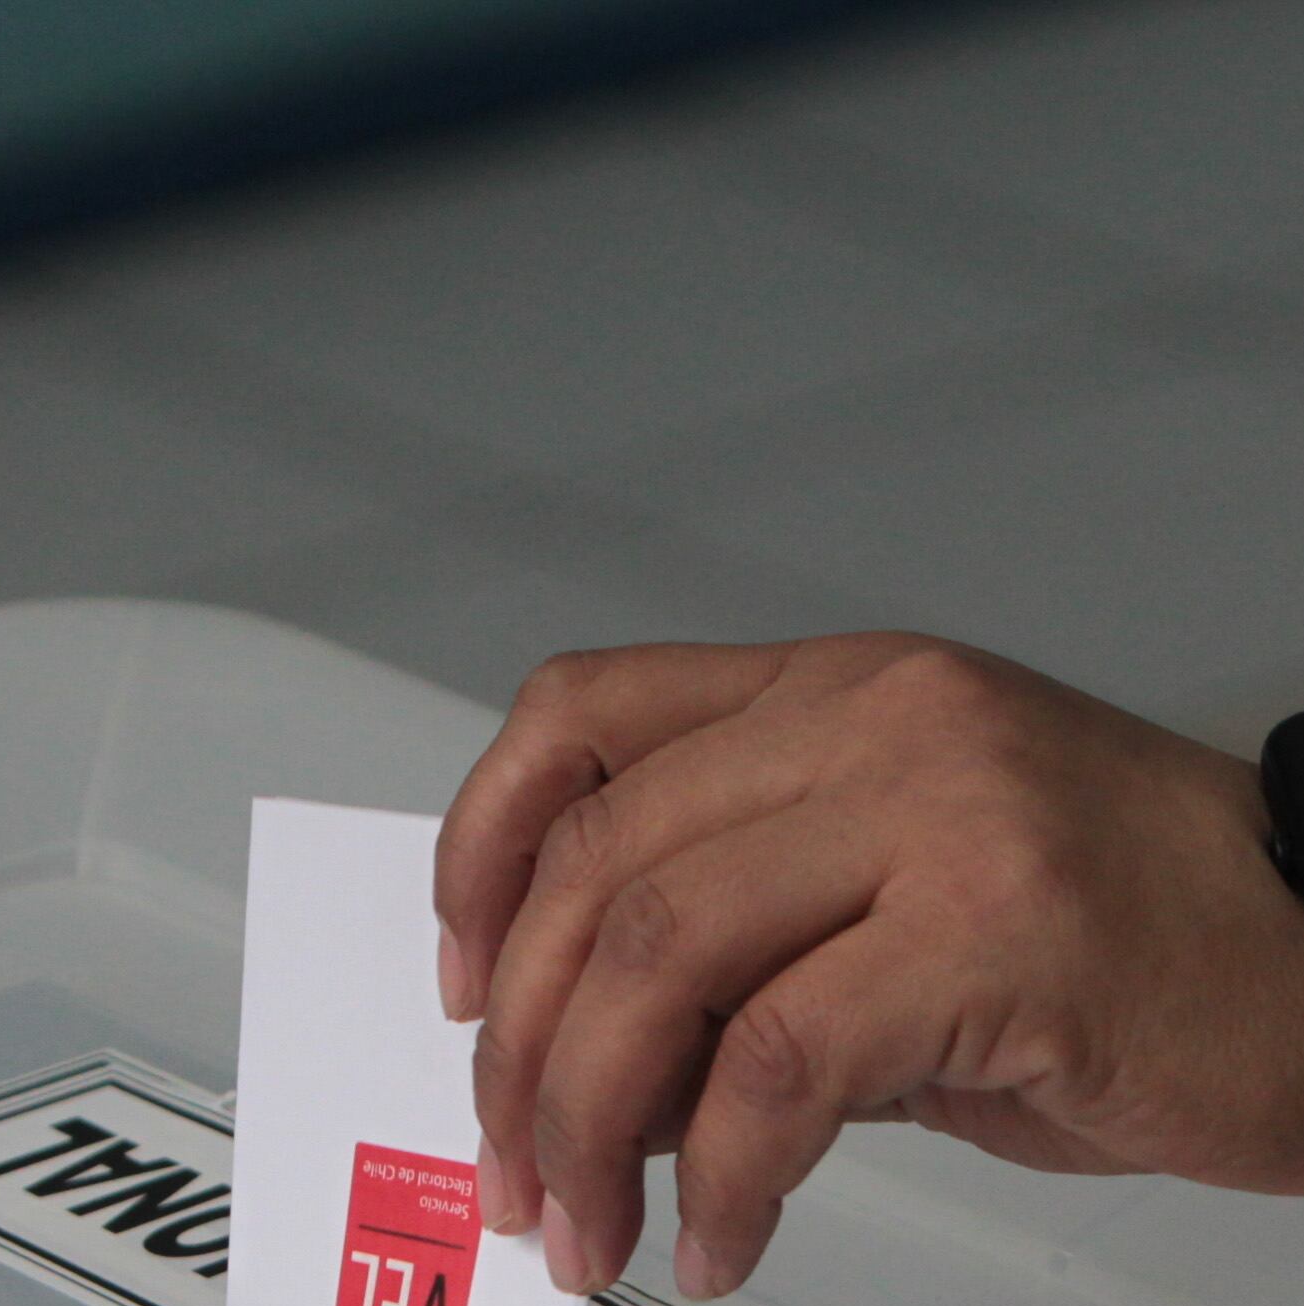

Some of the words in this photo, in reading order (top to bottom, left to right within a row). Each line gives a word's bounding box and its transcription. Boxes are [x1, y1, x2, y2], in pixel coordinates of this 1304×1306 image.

[362, 1160, 396, 1181] Chile
[398, 1168, 415, 1184] de
[417, 1173, 473, 1197] Electoral
[419, 1195, 470, 1220] Servicio
